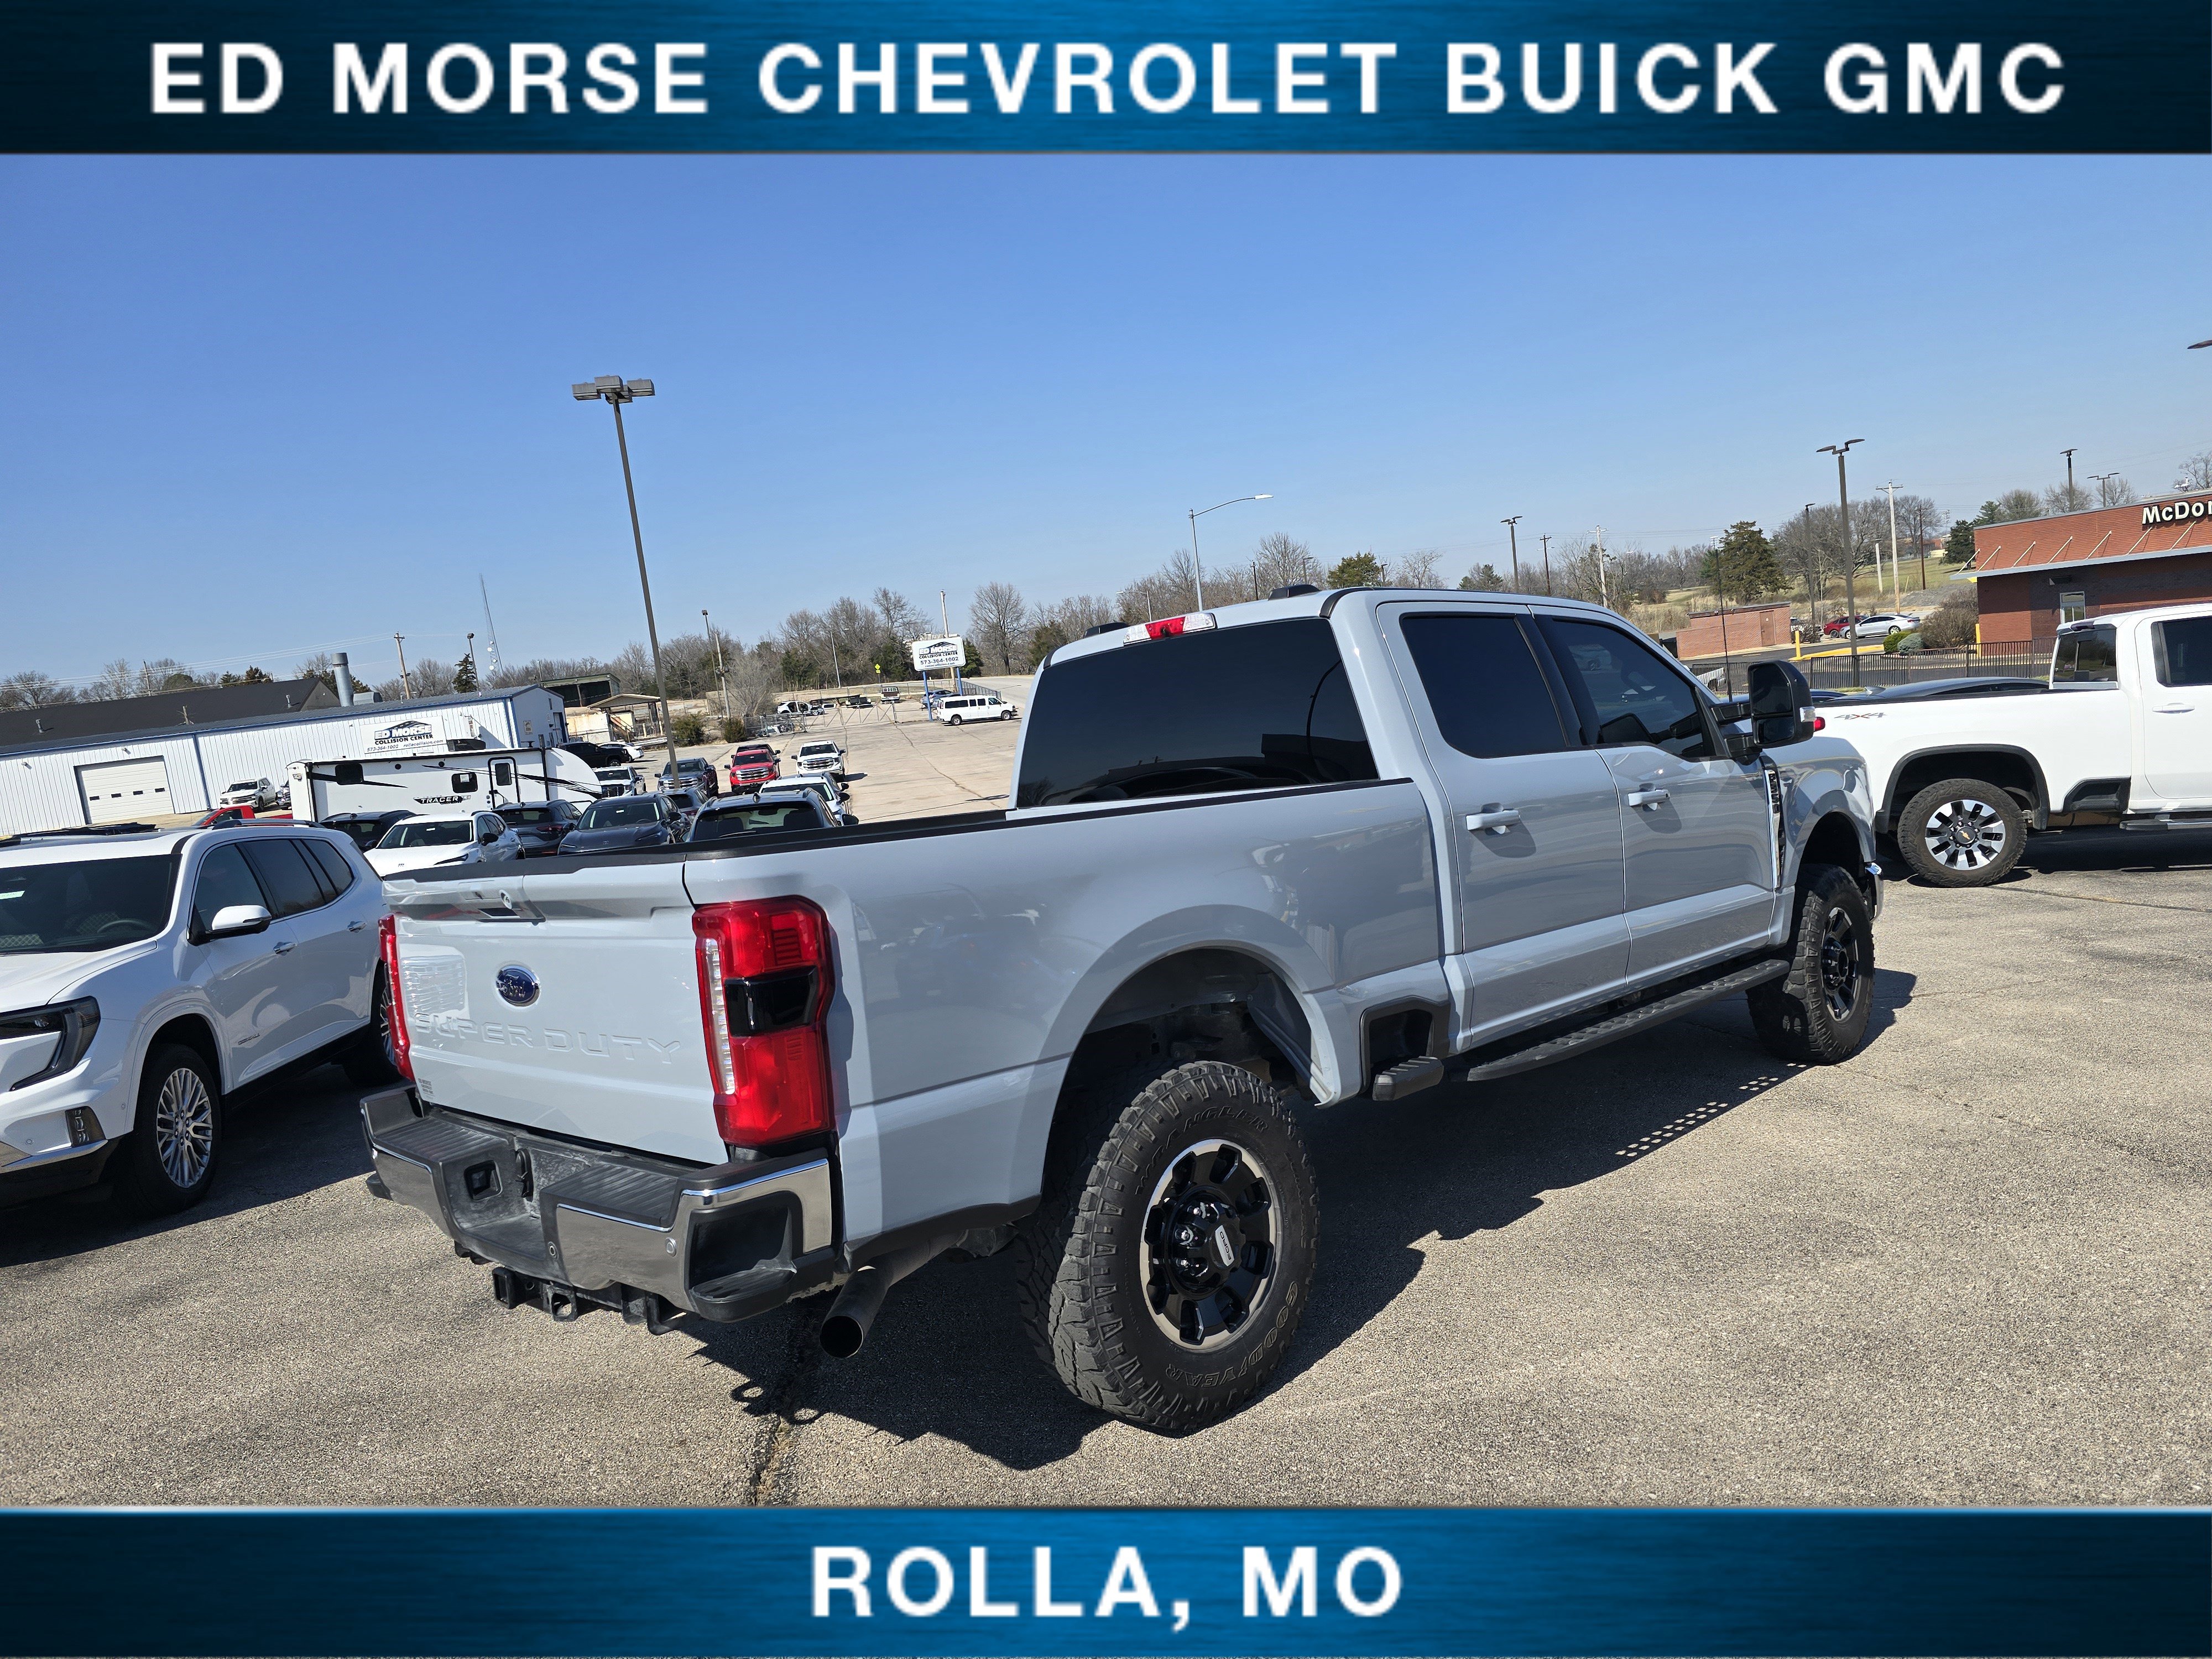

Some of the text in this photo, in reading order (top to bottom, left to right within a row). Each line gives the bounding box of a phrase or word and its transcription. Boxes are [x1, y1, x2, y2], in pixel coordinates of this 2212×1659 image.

[920, 656, 959, 665] 573-364-1002
[374, 724, 432, 740] ED MORSE
[420, 796, 458, 804] TRACER
[414, 1011, 681, 1065] SUPER DUTY
[1219, 1231, 1232, 1260] FORD
[1165, 1281, 1298, 1388] GOODYEAR
